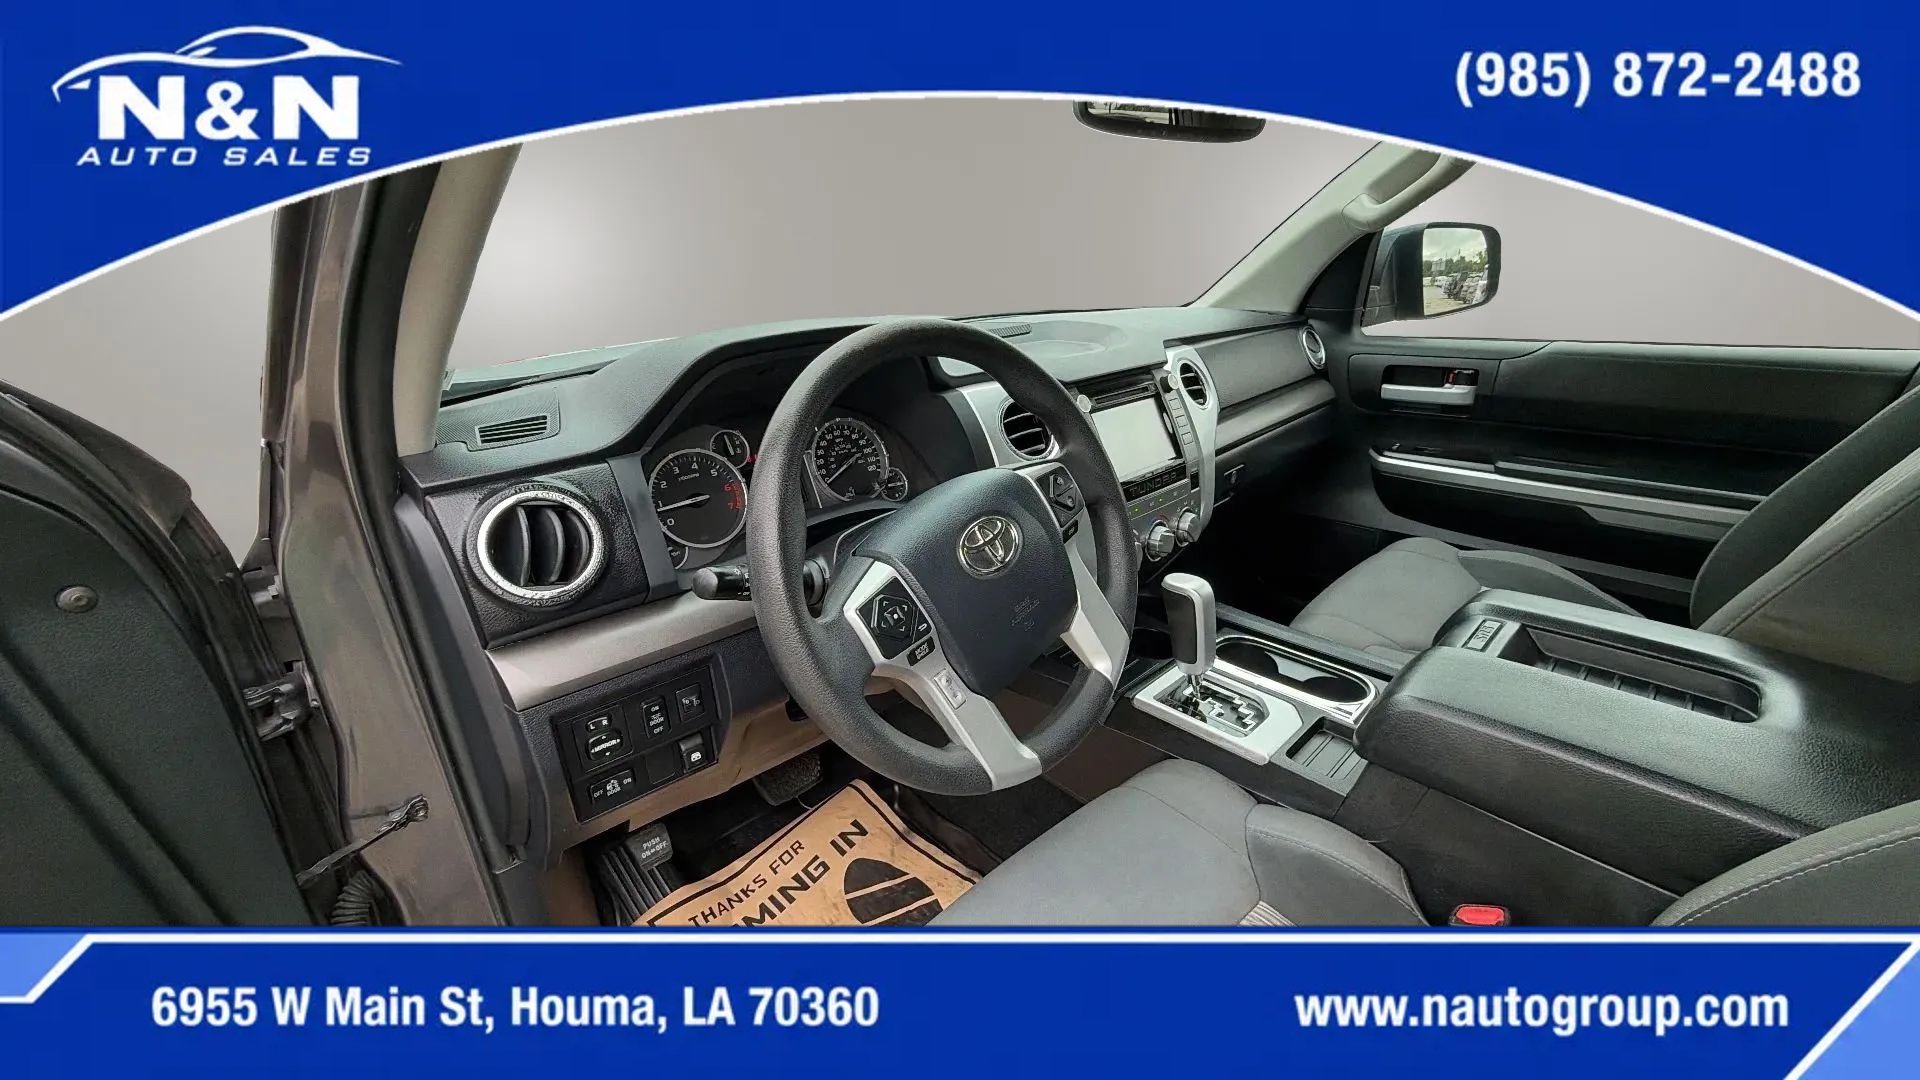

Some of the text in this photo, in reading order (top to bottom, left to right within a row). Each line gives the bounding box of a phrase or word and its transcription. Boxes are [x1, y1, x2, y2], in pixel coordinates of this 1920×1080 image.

[642, 836, 661, 850] PUSH
[829, 819, 869, 857] IN
[688, 840, 805, 926] THANKS FOR
